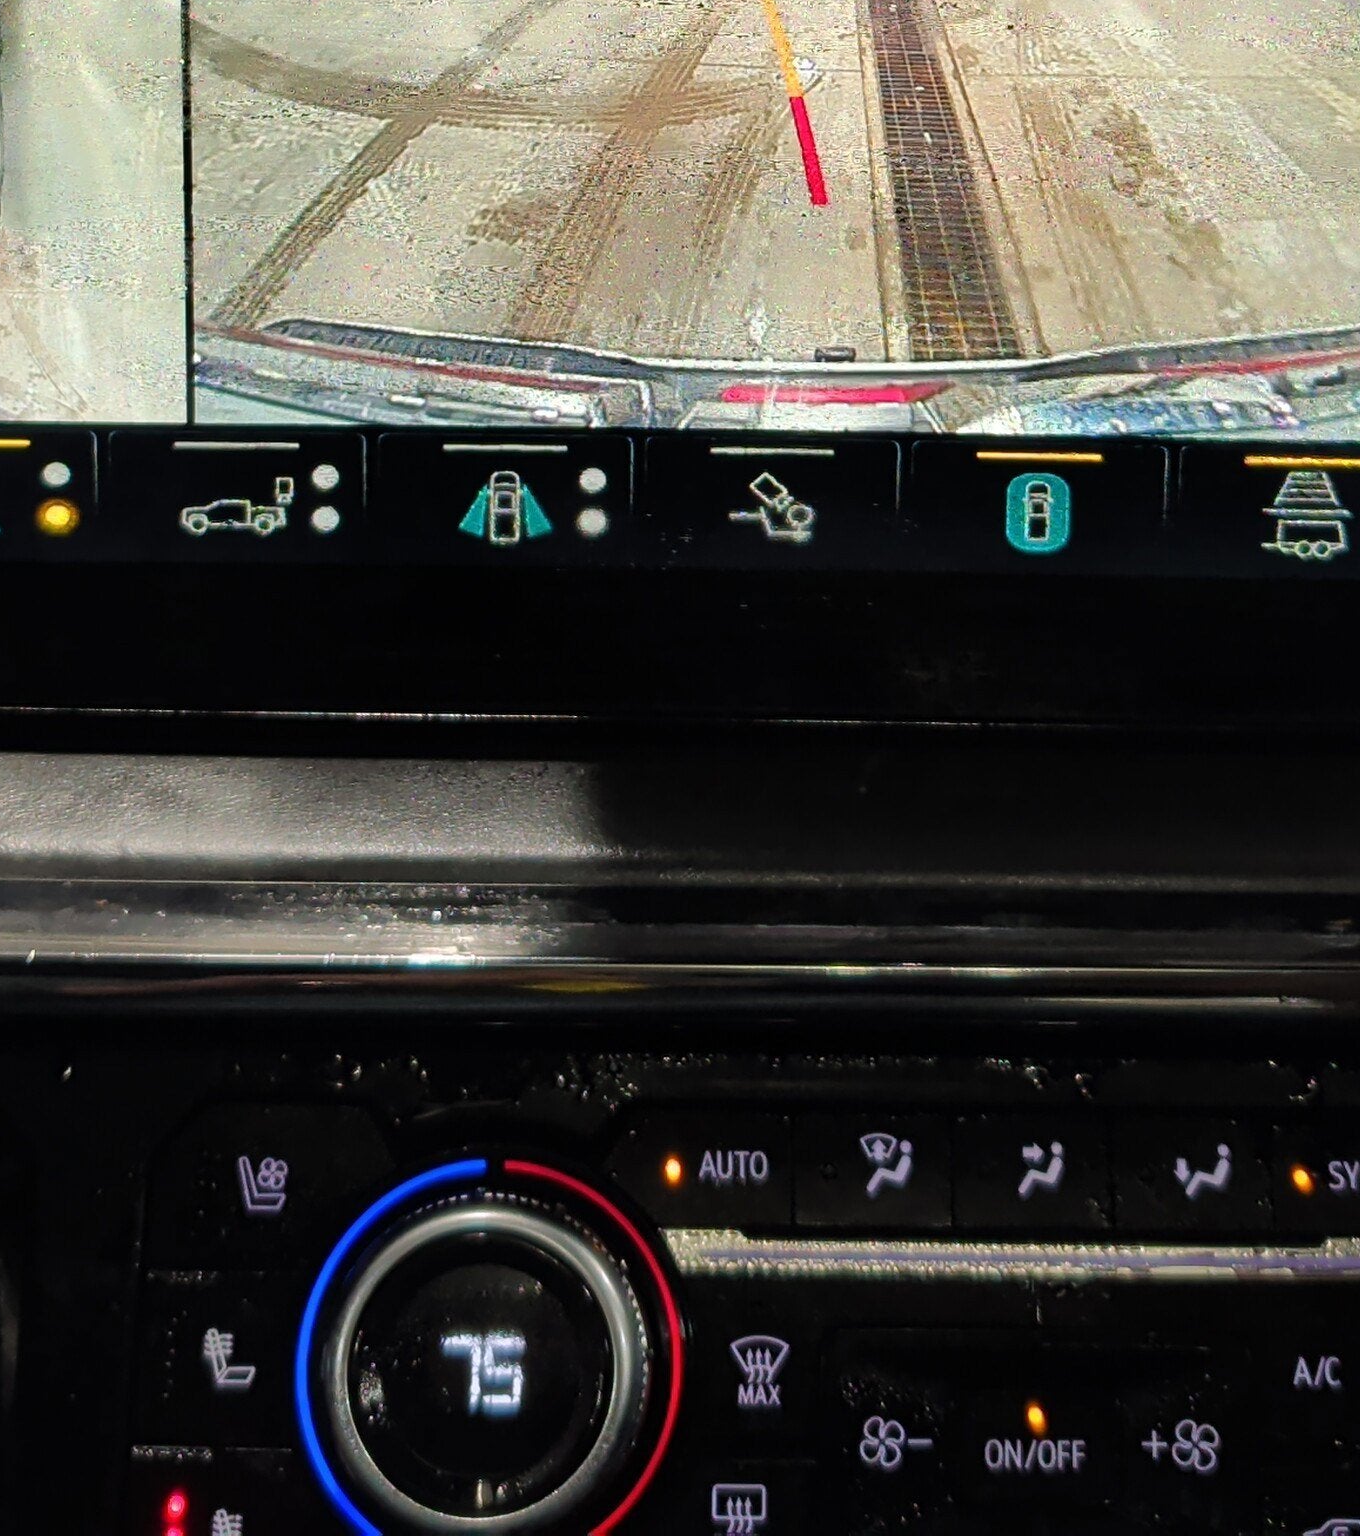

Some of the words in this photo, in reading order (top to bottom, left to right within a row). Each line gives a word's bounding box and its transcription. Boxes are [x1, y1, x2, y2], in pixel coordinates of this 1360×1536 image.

[699, 1151, 768, 1182] AUTO
[441, 1331, 527, 1416] 75
[1293, 1356, 1341, 1387] A/C
[737, 1382, 781, 1406] MAX
[984, 1439, 1085, 1469] ON/OFF
